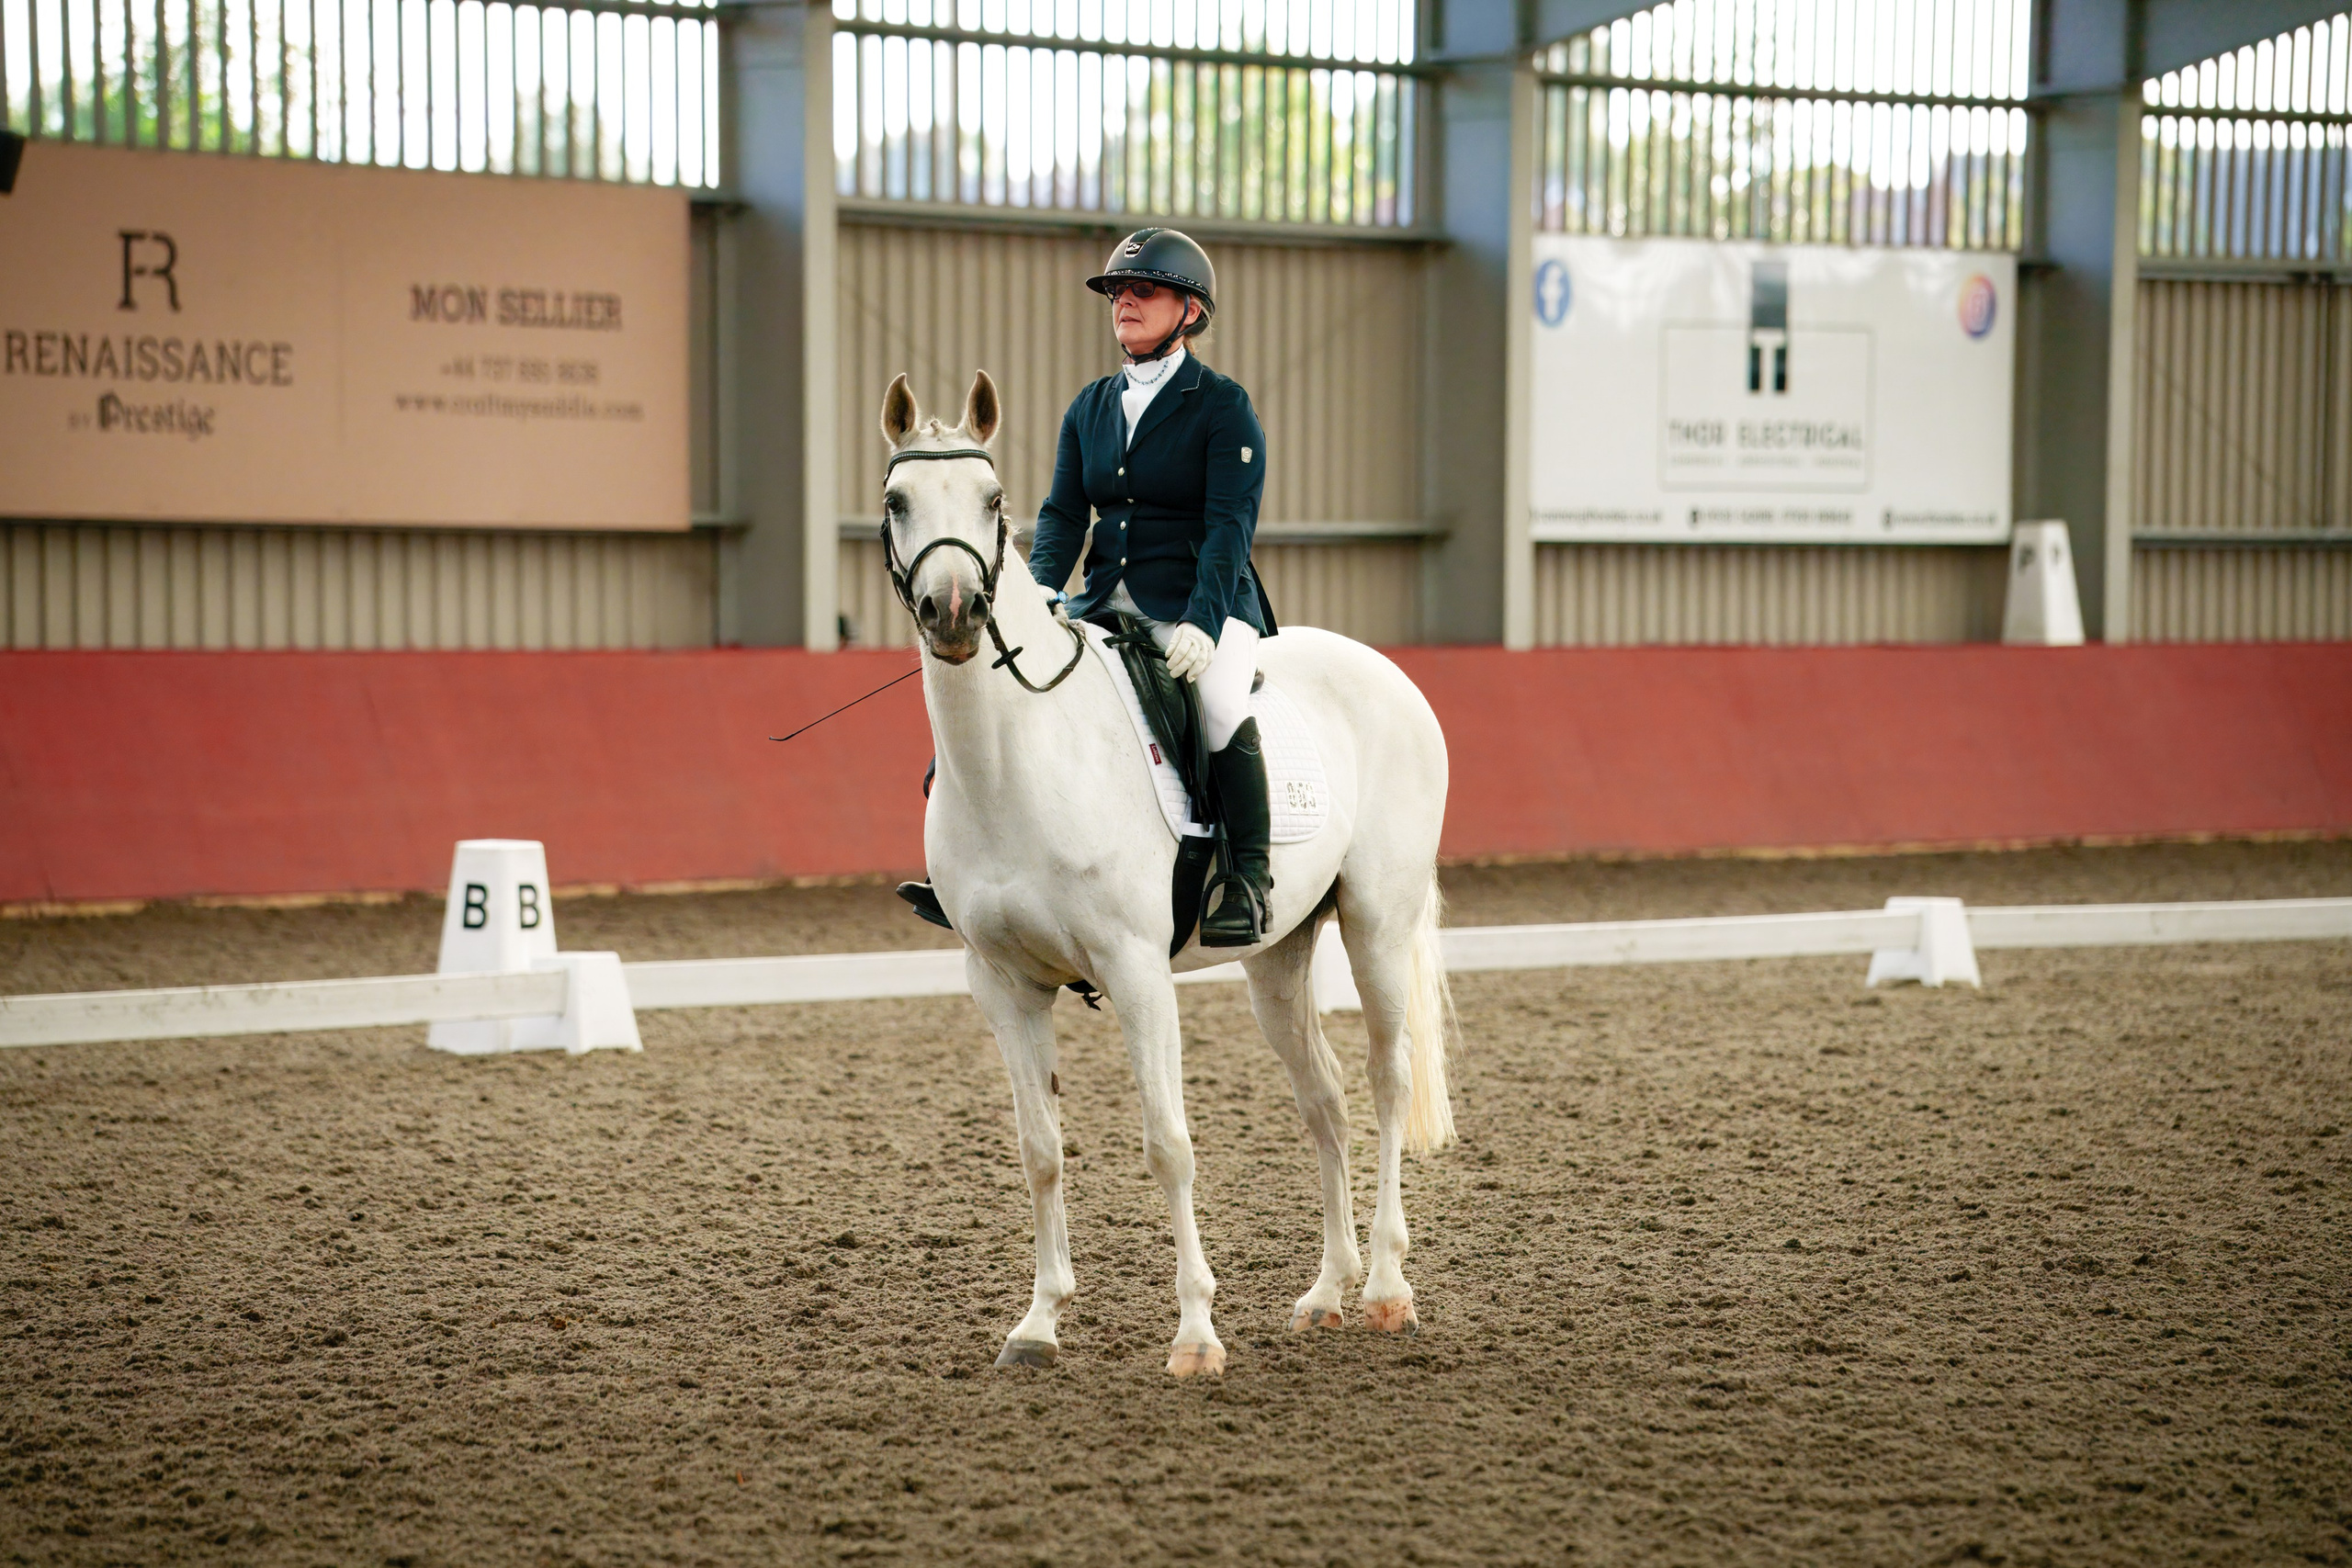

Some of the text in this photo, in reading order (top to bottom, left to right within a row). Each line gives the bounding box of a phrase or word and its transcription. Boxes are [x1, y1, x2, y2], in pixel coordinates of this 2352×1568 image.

[410, 283, 487, 324] MON
[6, 329, 294, 387] RENAISSANCE
[463, 884, 540, 929] B B
